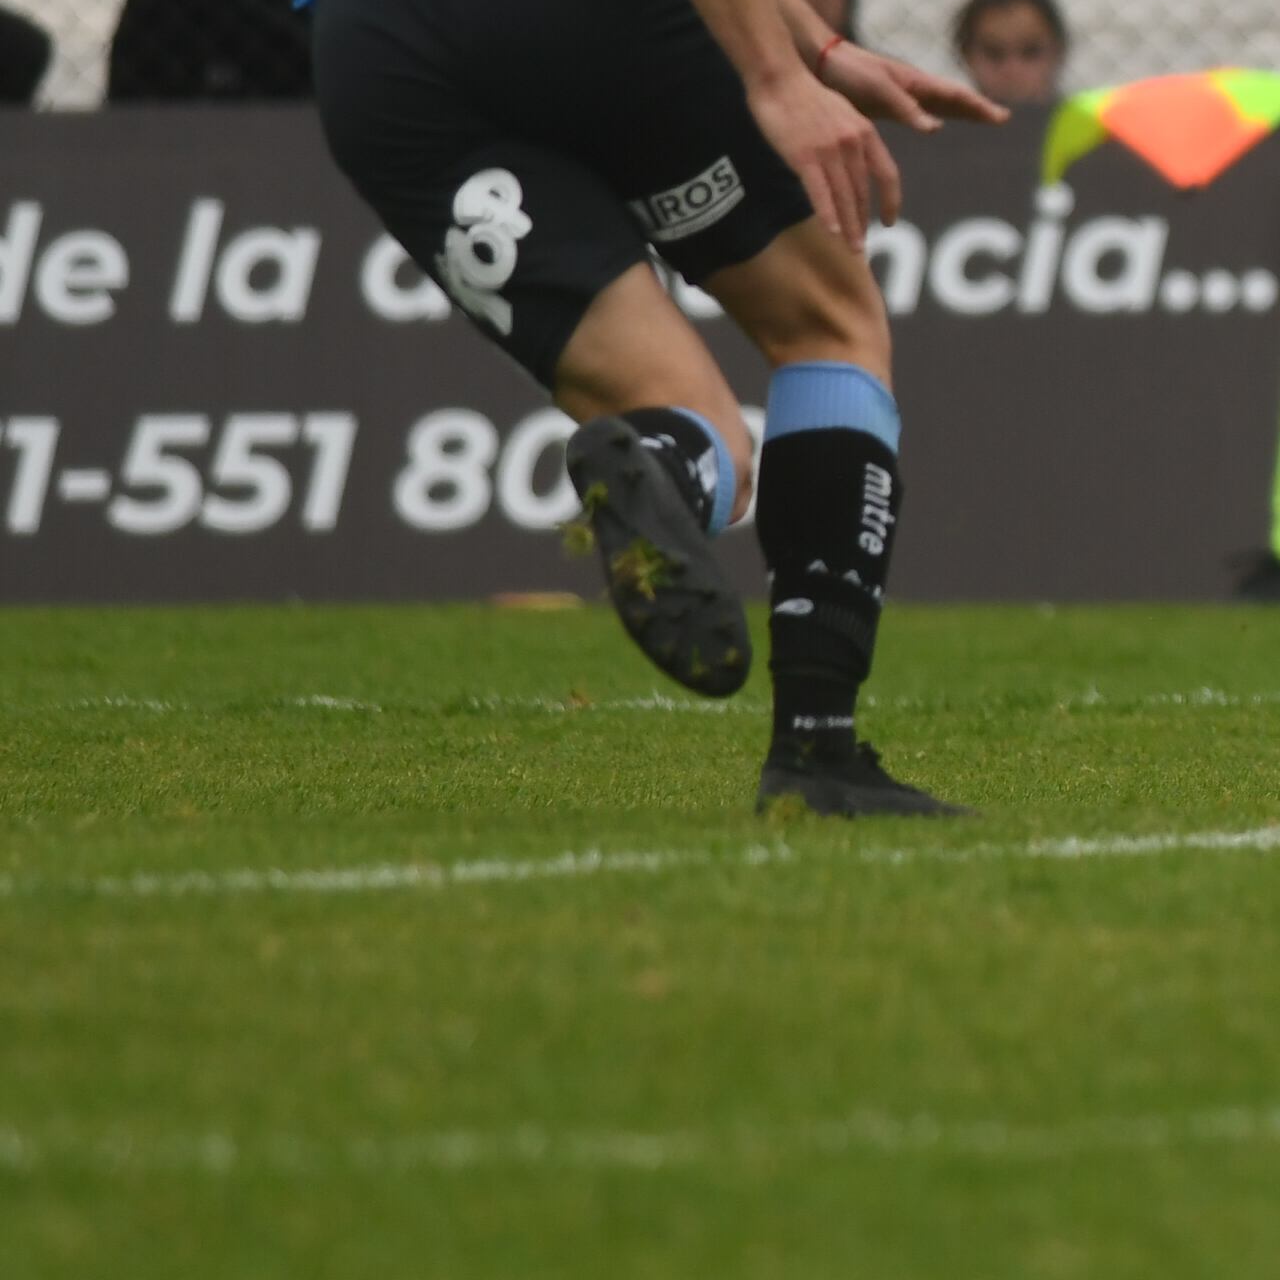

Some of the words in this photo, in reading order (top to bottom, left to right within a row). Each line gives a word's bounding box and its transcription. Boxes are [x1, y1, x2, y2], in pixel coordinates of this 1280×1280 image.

[169, 198, 321, 322] la
[0, 412, 357, 534] 1-551
[858, 461, 895, 556] mitre
